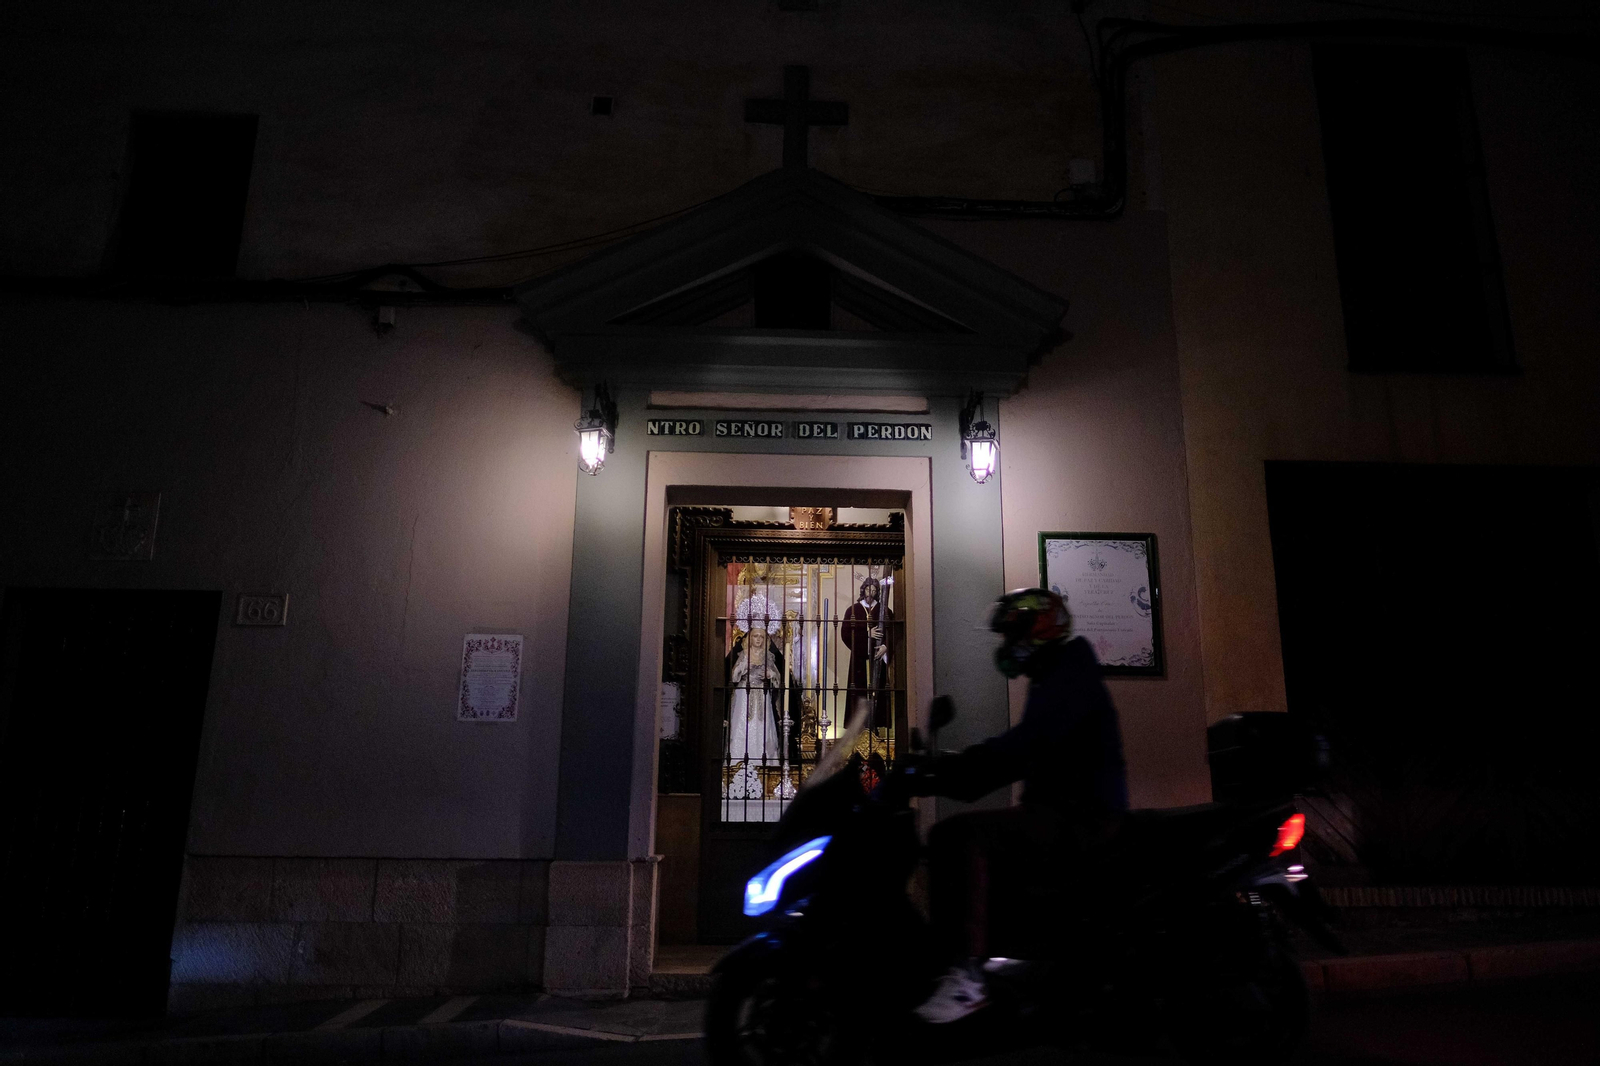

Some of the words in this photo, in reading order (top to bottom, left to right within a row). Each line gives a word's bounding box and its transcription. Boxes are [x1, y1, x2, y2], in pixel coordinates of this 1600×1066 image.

[647, 421, 701, 435] NTRO
[716, 421, 782, 438] SEÑOR
[799, 423, 838, 438] DEL
[853, 424, 932, 440] PERDON
[801, 507, 823, 515] PAZ
[799, 521, 823, 529] BIEN
[248, 600, 278, 620] 66
